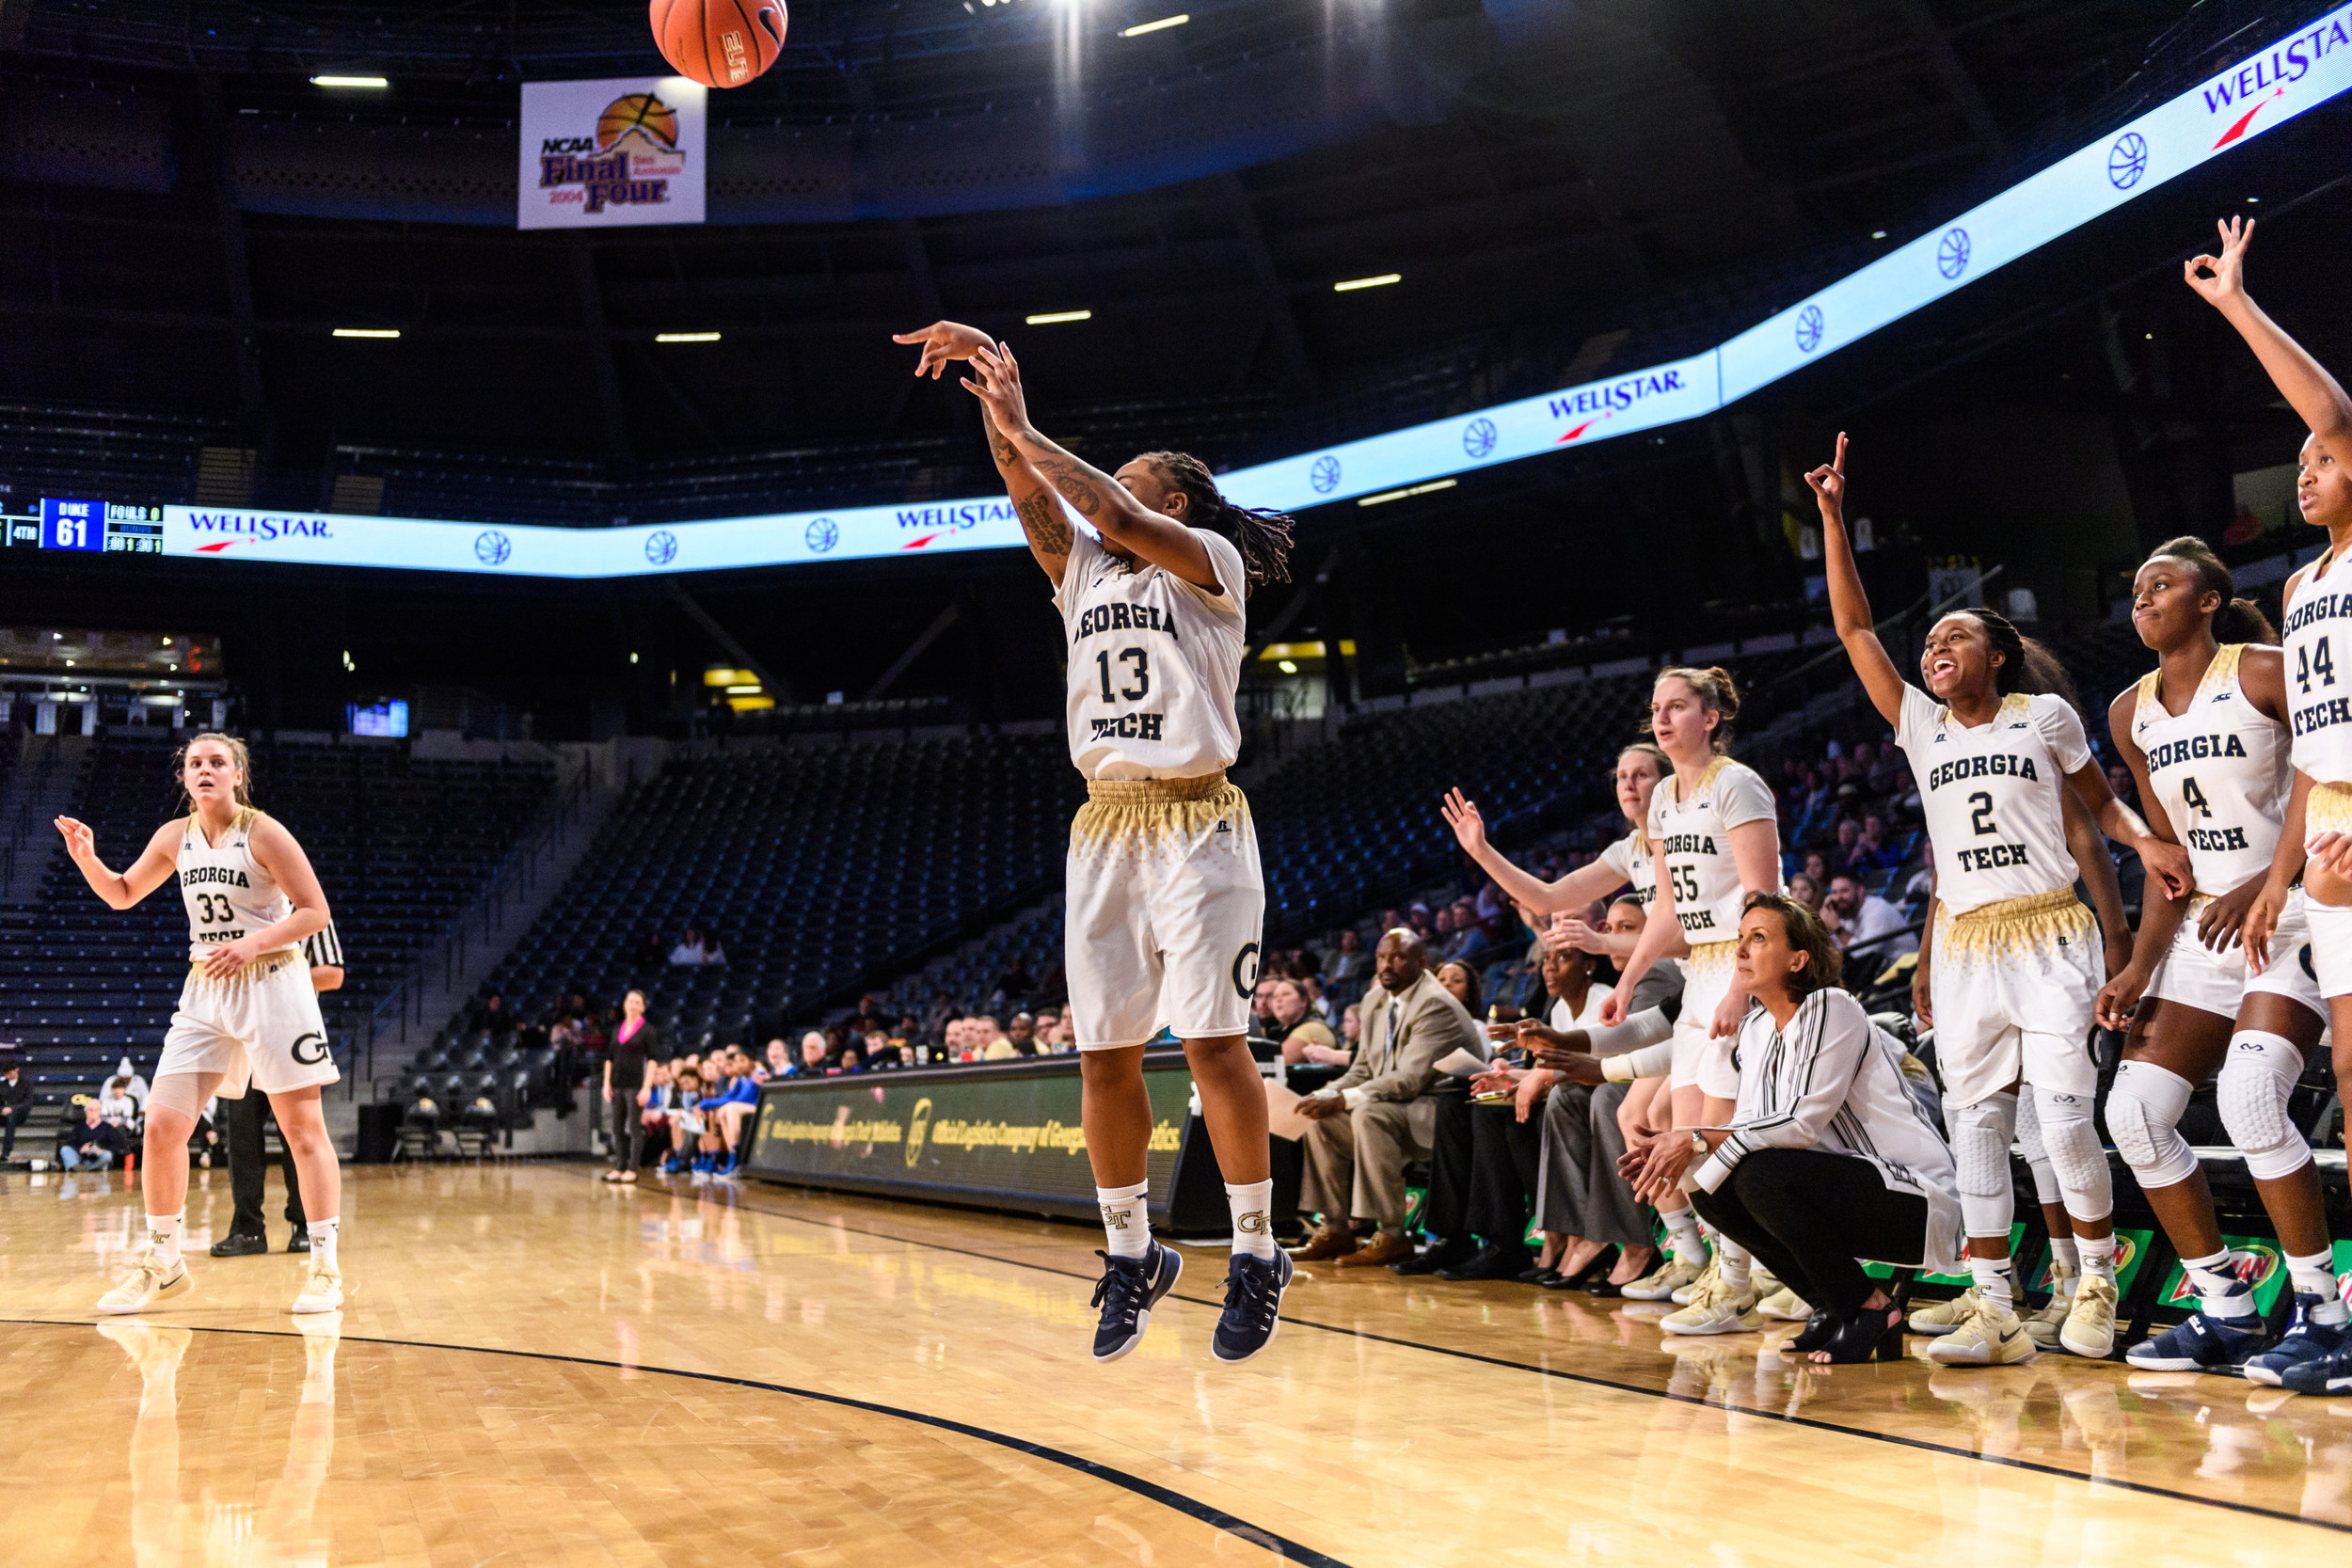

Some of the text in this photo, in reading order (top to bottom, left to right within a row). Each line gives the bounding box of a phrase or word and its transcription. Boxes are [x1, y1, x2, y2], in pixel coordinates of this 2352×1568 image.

[722, 30, 748, 83] ELITE
[2203, 11, 2352, 114] WELLSTA
[542, 137, 594, 154] NCAA
[540, 150, 629, 187] Final
[548, 191, 584, 204] 2004
[583, 180, 668, 214] Four
[1549, 370, 1686, 420] WELLSTAR
[58, 501, 90, 516] DUKE
[110, 504, 148, 520] FOULS
[12, 525, 38, 540] 4TH
[56, 517, 87, 547] 61
[190, 513, 333, 540] WELLSTAR
[126, 537, 135, 551] 1
[154, 539, 162, 553] 1
[2283, 593, 2352, 641] EORGIA
[1096, 646, 1150, 704] 13
[2296, 635, 2336, 695] 44
[1930, 754, 2039, 792] GEORGIA
[1968, 791, 1998, 836] 2
[2183, 775, 2213, 818] 4
[1957, 844, 2029, 872] TECH
[183, 866, 250, 889] GEORGIA
[1670, 865, 1699, 903] 55
[197, 894, 235, 925] 33
